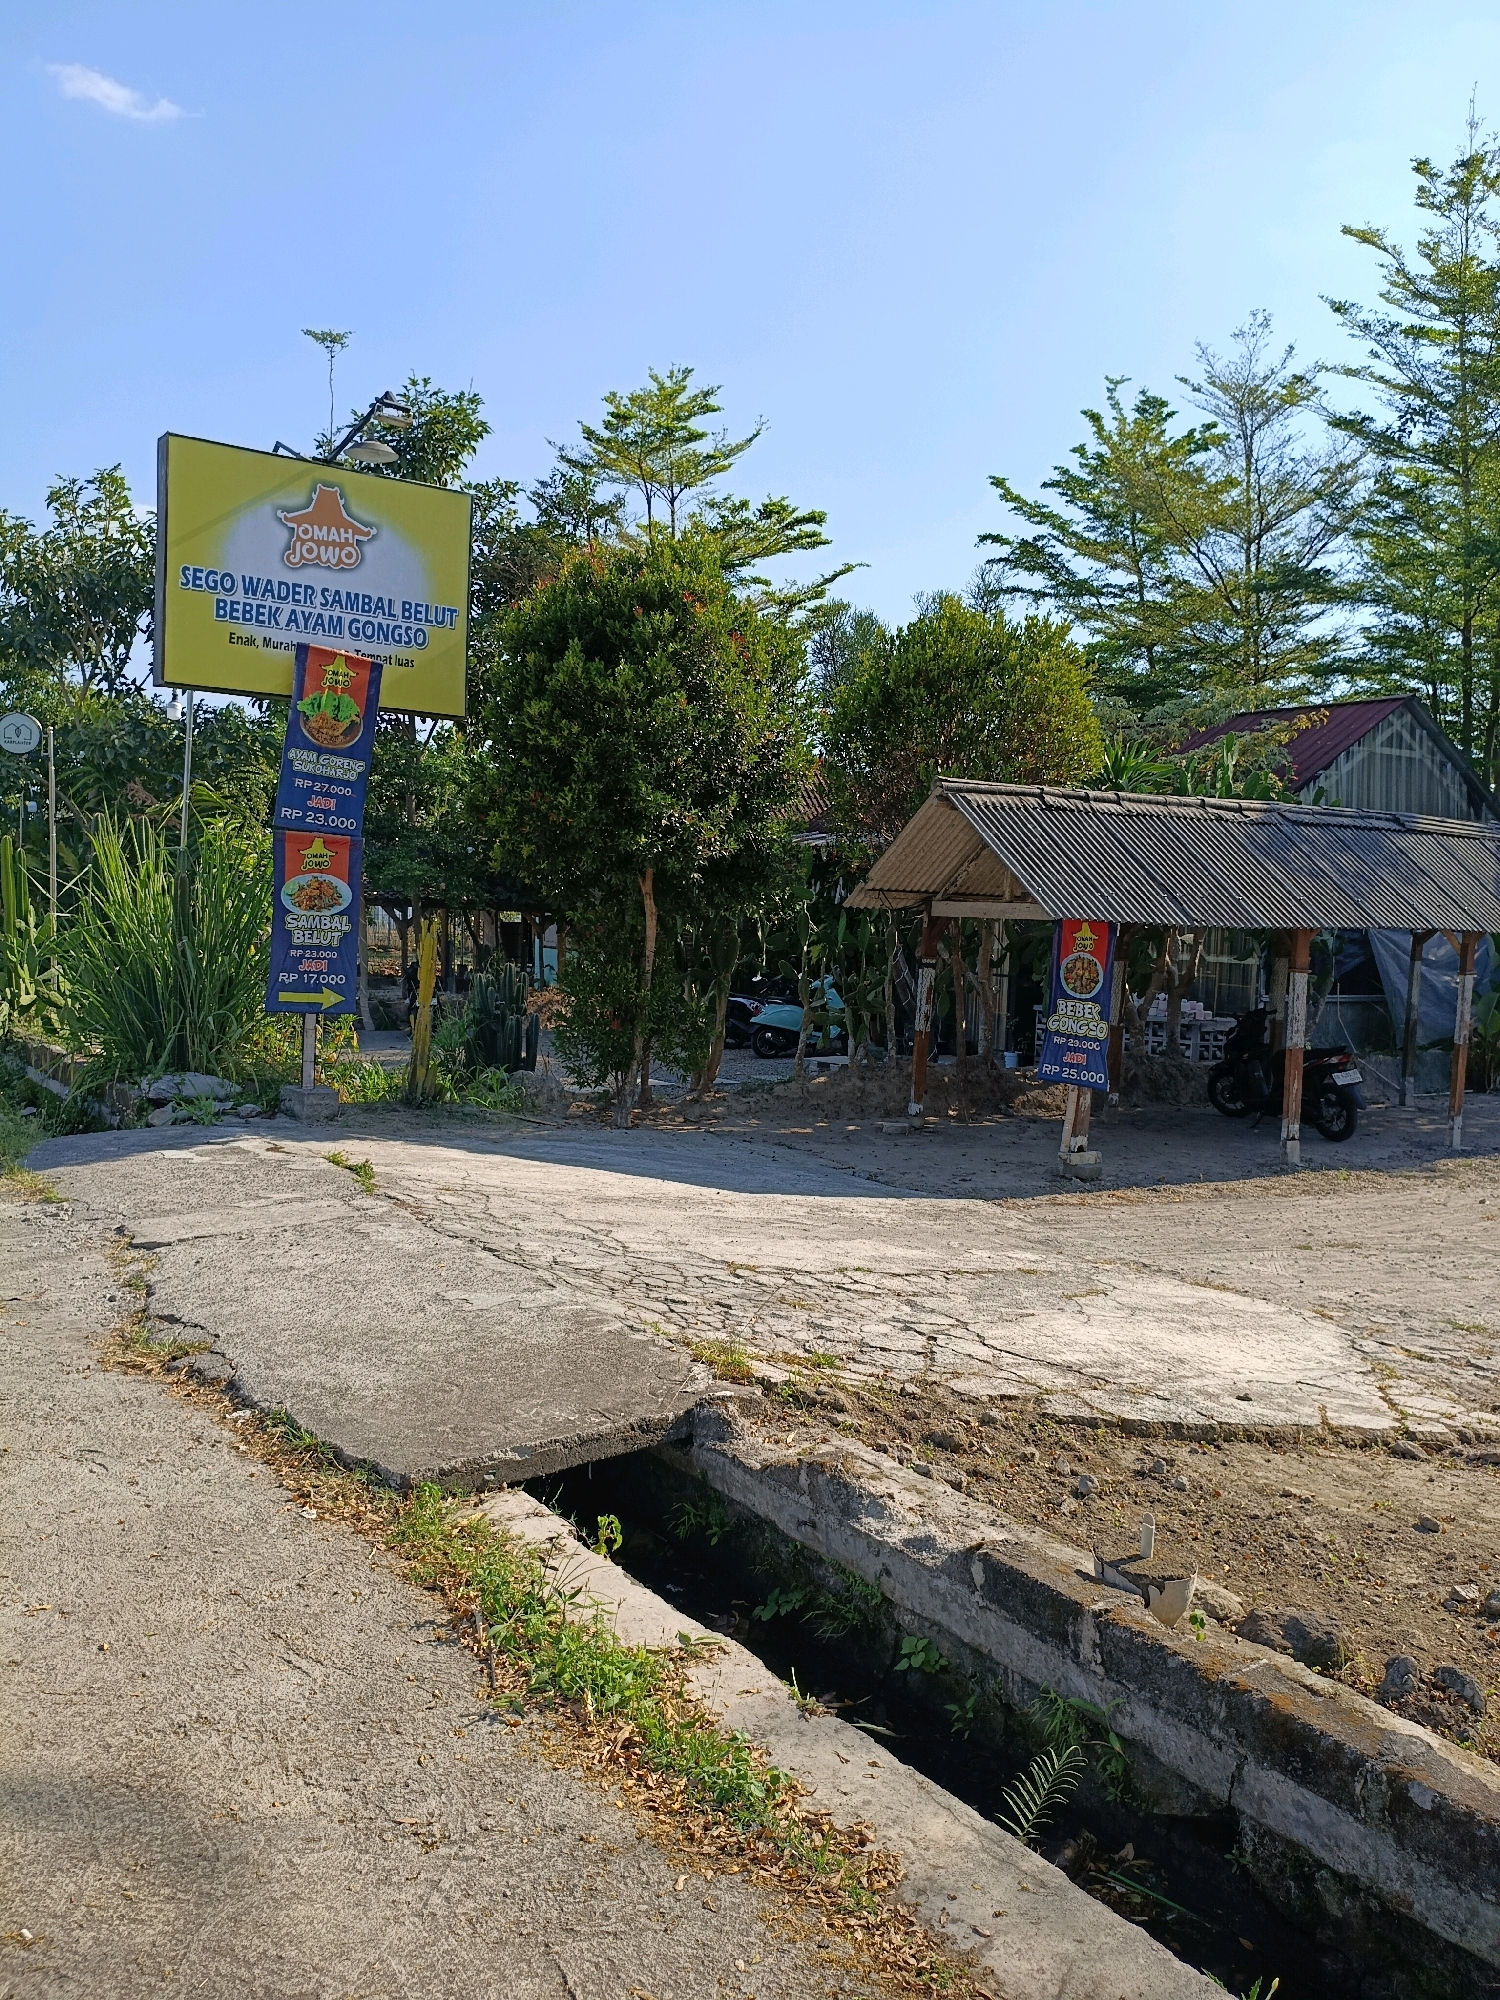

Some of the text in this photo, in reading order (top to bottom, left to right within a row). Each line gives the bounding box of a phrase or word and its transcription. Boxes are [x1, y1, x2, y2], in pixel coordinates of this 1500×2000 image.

[298, 523, 353, 543] OMAH
[290, 542, 358, 565] JOWO
[179, 565, 459, 630] SEGO WADER SAMBAL BELUT
[214, 598, 429, 650] BEBEK AYAM GONGSO
[229, 632, 259, 649] Enak,
[395, 654, 415, 668] luas
[323, 677, 351, 687] JOWO
[327, 670, 350, 679] OMAH
[288, 748, 365, 773] AYAM GORENG
[293, 761, 359, 781] SUKOHARJO
[295, 778, 351, 796] RP 27.000
[307, 795, 336, 811] JADI
[281, 807, 357, 830] RP 23.000
[303, 860, 330, 869] JOWO
[285, 913, 351, 932] SAMBAL
[292, 929, 344, 947] BELUT
[290, 949, 338, 959] RP 23.000
[298, 960, 328, 972] JADI
[278, 973, 346, 985] RP 17.000
[1057, 999, 1101, 1020] BEBEK
[1047, 1014, 1109, 1039] GONGSO
[1053, 1036, 1066, 1044] RP
[1063, 1052, 1087, 1065] JADI
[1042, 1064, 1105, 1083] RP 25.000
